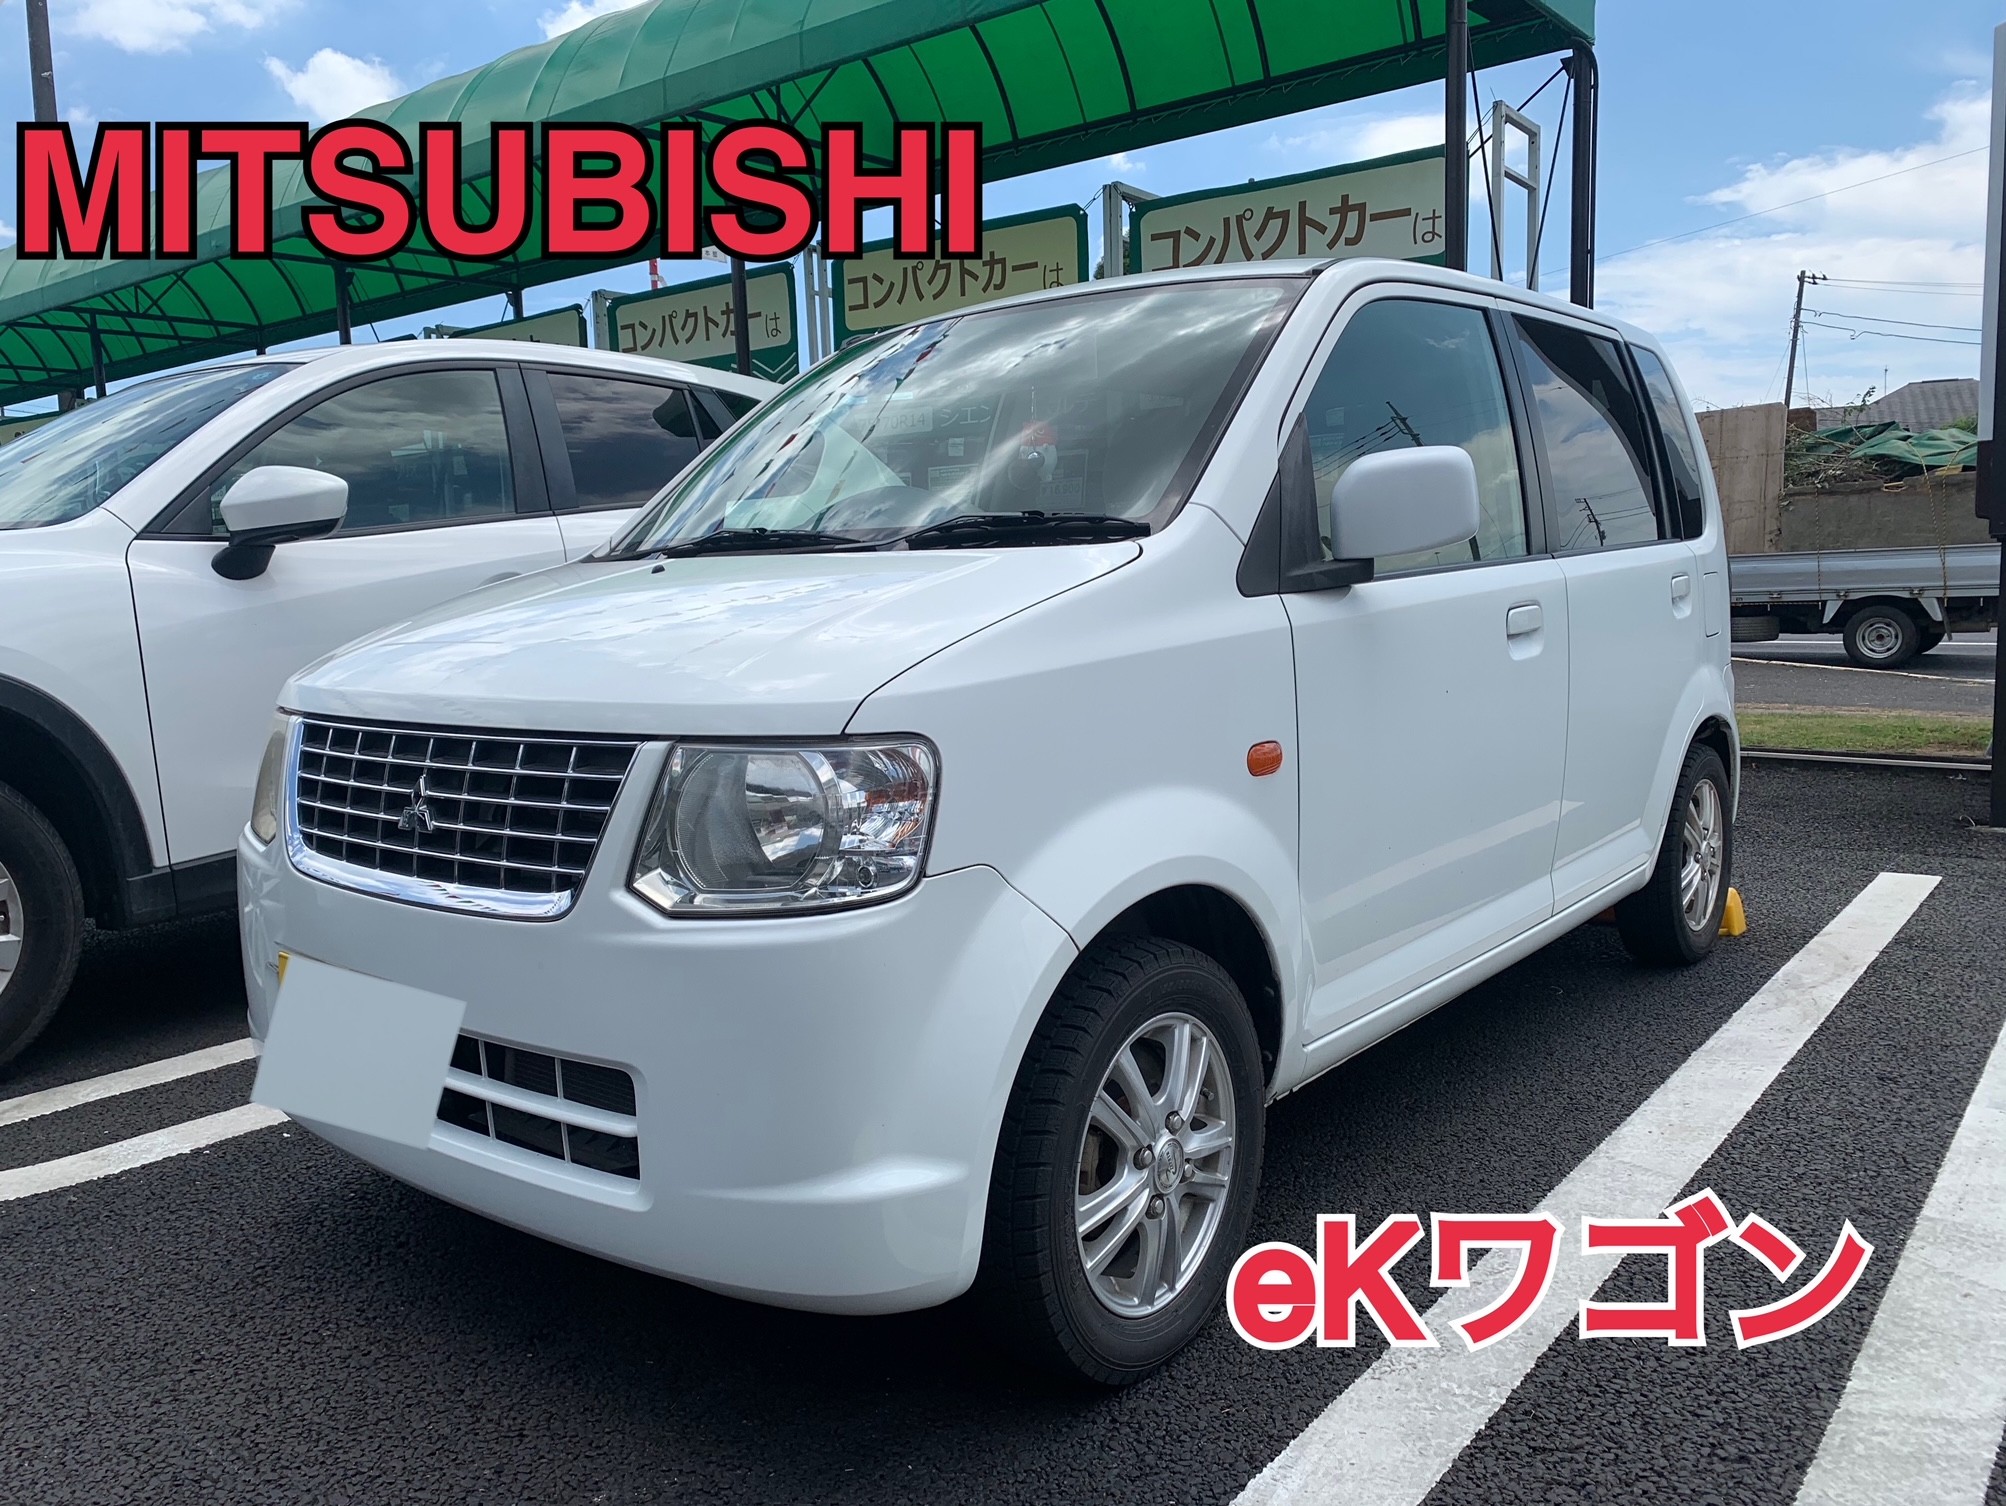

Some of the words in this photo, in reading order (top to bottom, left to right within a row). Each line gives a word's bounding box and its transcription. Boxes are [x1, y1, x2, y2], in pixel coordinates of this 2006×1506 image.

[1150, 193, 1443, 272] コンパクトカーは
[847, 250, 1065, 311] コンパクトカーは
